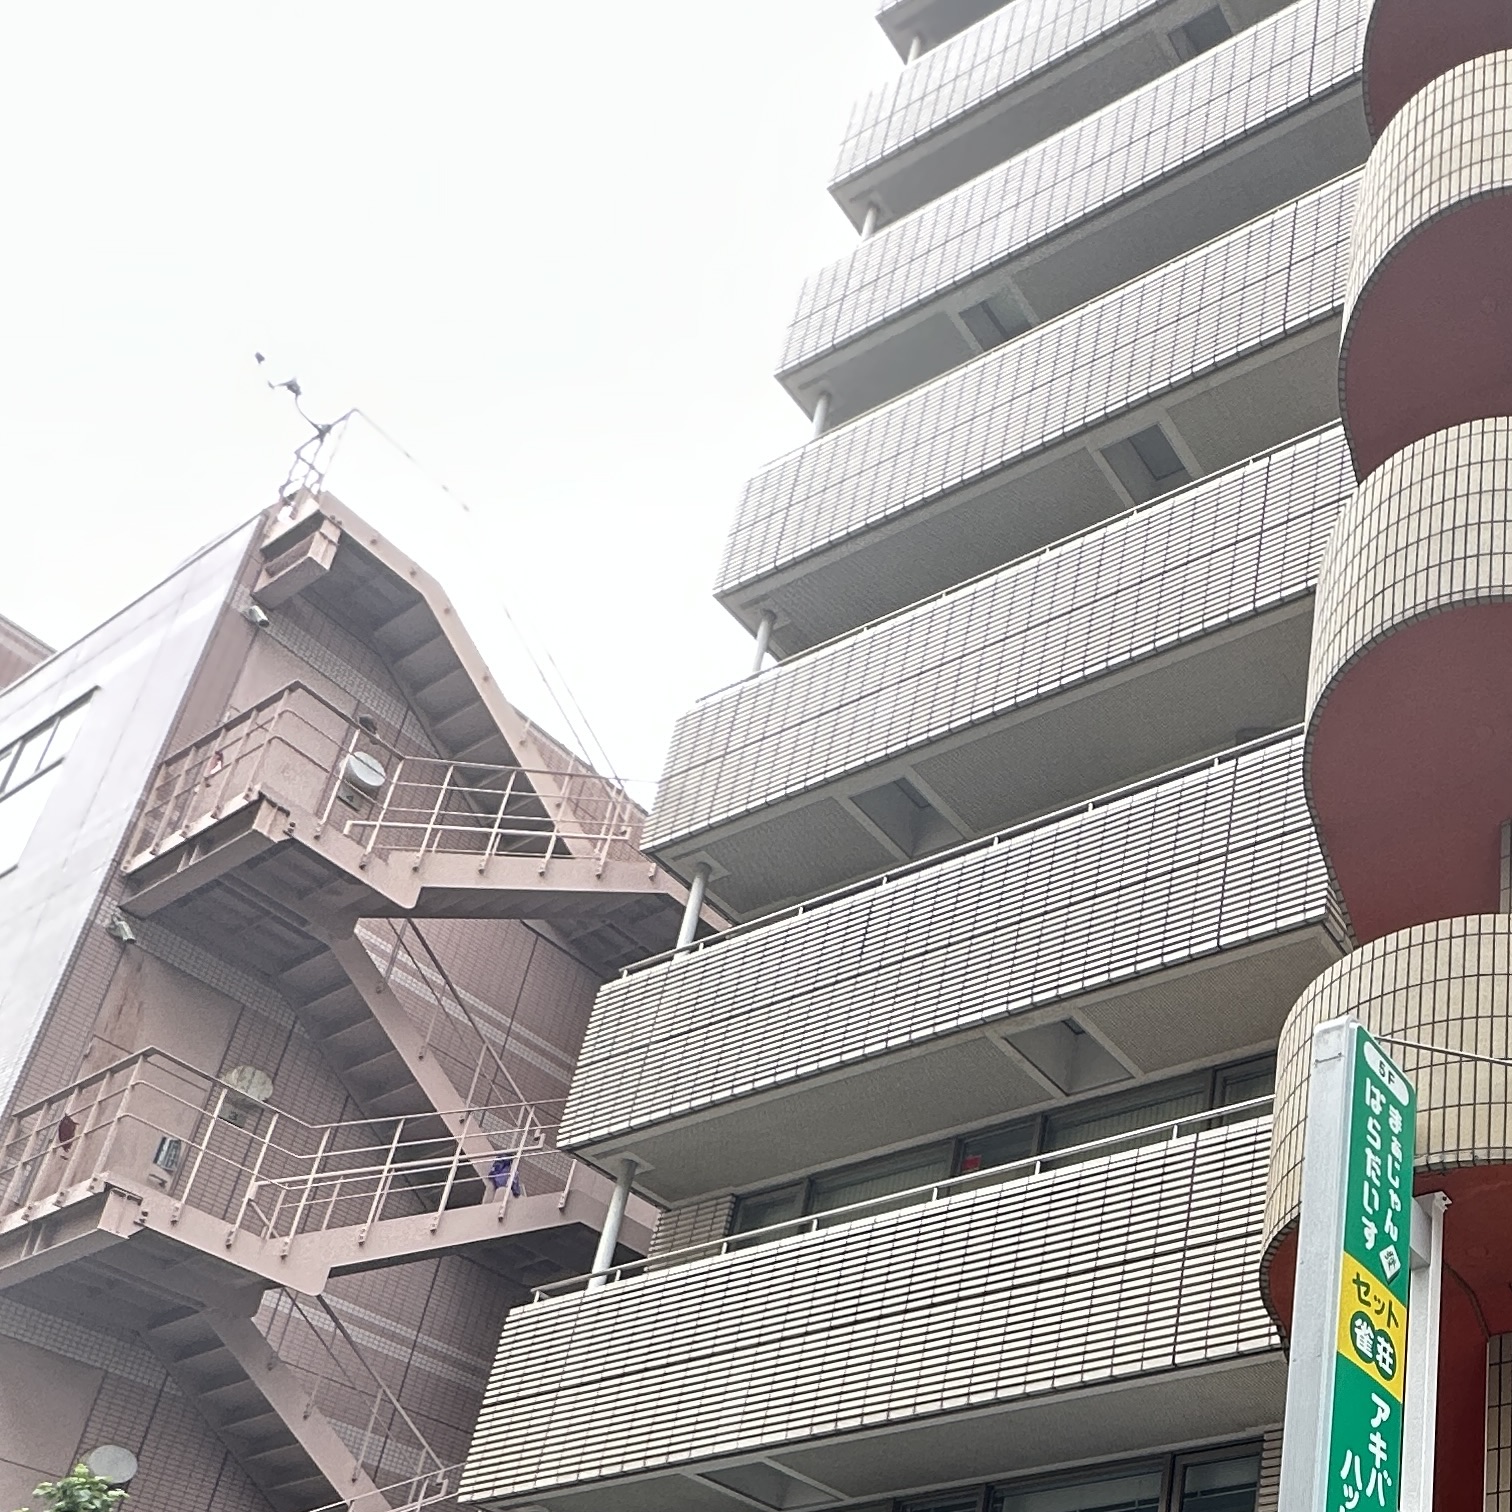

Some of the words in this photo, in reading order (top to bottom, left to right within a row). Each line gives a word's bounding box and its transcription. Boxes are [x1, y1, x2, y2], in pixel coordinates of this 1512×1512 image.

[1378, 1061, 1396, 1086] 5F
[1352, 1272, 1399, 1328] セット
[1354, 1318, 1395, 1376] 雀荘
[1366, 1393, 1392, 1507] アキバ
